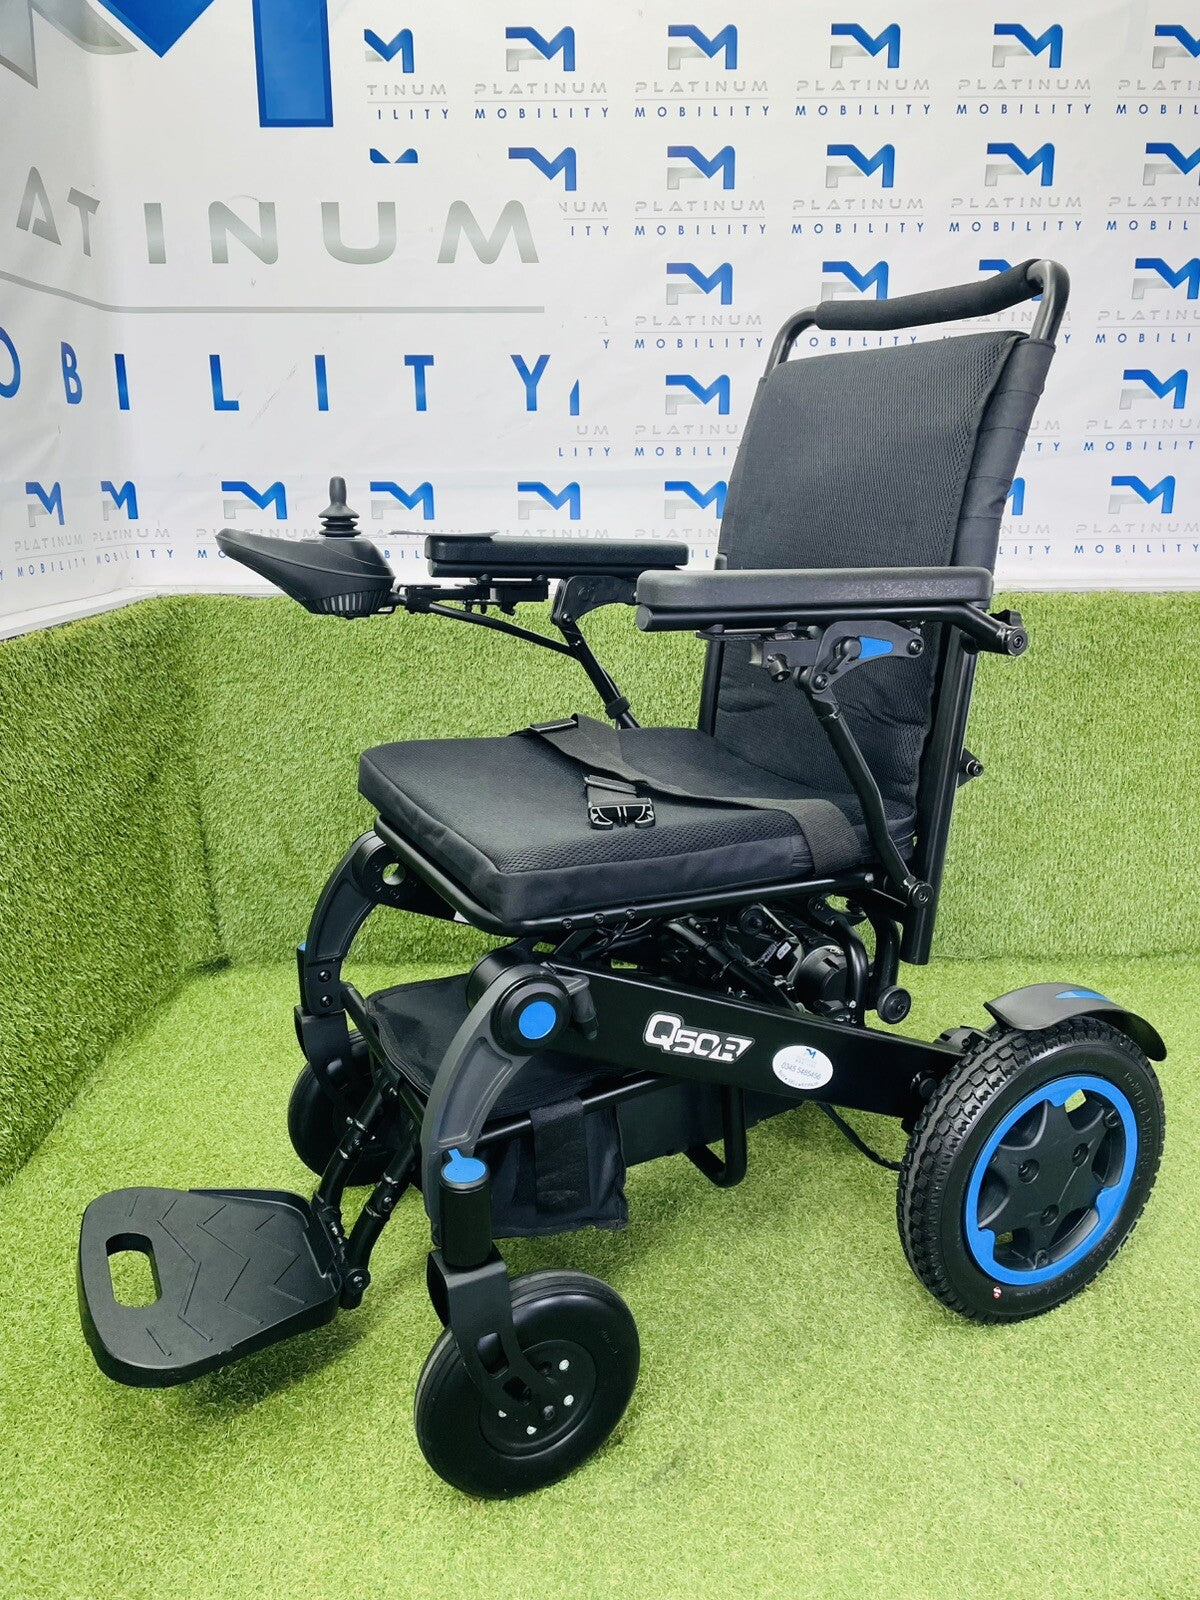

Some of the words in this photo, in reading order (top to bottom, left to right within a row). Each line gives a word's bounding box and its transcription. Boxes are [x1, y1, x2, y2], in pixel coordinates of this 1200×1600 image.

[367, 84, 447, 97] TINUM
[475, 82, 607, 95] PLATINUM
[635, 80, 769, 94] PLATINUM
[796, 79, 930, 92] PLATINUM
[958, 78, 1091, 91] PLATINUM
[1117, 78, 1200, 91] PLATI
[475, 106, 608, 119] MOBILITY
[635, 105, 769, 118] MOBILITY
[795, 103, 931, 116] MOBILITY
[956, 103, 1092, 116] MOBILITY
[635, 200, 766, 213] PLATINUM
[792, 198, 924, 211] PLATINUM
[951, 197, 1082, 209] PLATINUM
[635, 223, 766, 236] MOBILITY
[791, 221, 925, 234] MOBILITY
[949, 219, 1083, 232] MOBILITY
[635, 315, 763, 326] PLATINUM
[635, 338, 764, 349] MOBILITY
[1085, 419, 1200, 431] PLATINU
[635, 446, 739, 457] MOBILI
[1074, 522, 1200, 535] PLATINUM
[92, 528, 170, 543] PLATINUM
[14, 535, 83, 552] PLATINUM
[1072, 543, 1200, 555] MOBILITY
[96, 548, 173, 565] MOBILITY
[18, 557, 88, 577] MOBILITY
